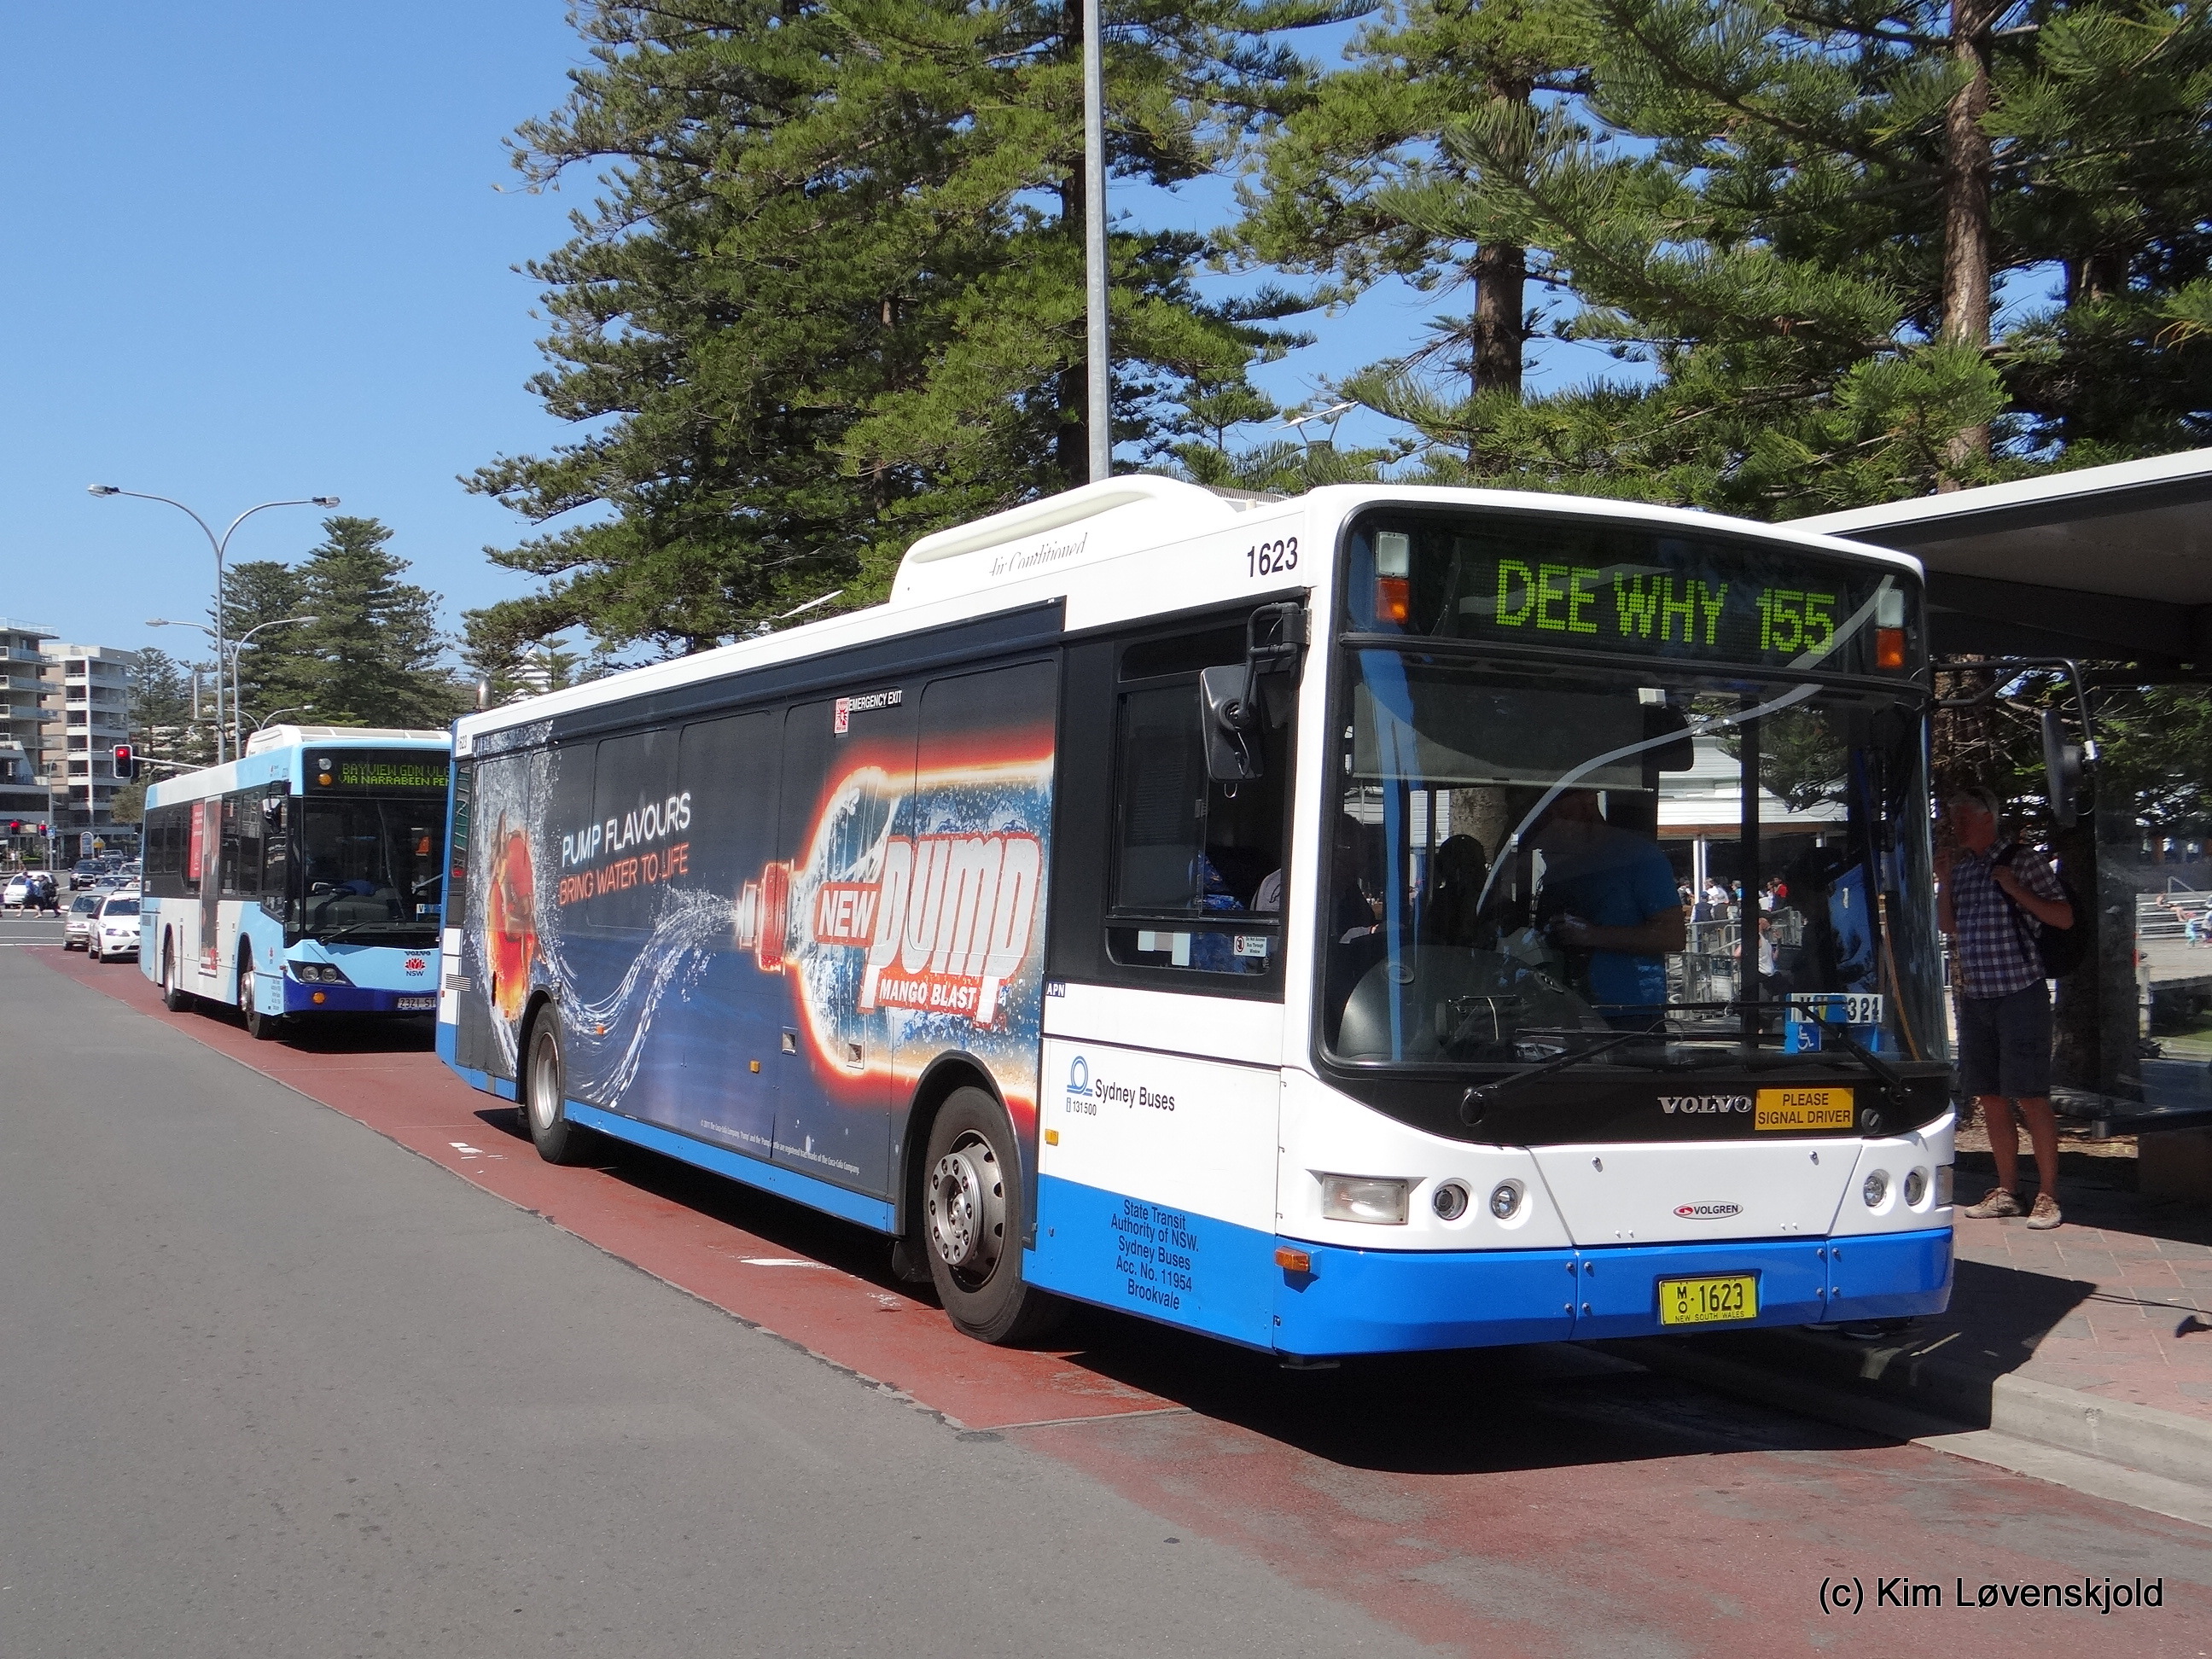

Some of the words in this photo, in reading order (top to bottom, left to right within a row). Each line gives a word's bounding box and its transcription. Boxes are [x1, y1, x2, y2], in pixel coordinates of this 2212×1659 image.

[1246, 536, 1299, 578] 1623
[1496, 558, 1599, 634] DEE
[1614, 571, 1729, 646] WHY
[1755, 587, 1836, 655] 155
[848, 693, 888, 712] EMERGENCY
[888, 690, 902, 705] EXIT
[338, 775, 358, 785] VIA
[360, 775, 430, 786] NARRABEEN
[342, 763, 397, 777] BAYVIEW
[399, 765, 424, 777] GDN
[562, 824, 601, 869] PUMP
[604, 792, 691, 854] FLAVOURS
[559, 871, 594, 906] BRING
[597, 859, 638, 895] WATER
[641, 853, 659, 884] TO
[661, 841, 690, 881] LIFE
[817, 889, 877, 939] NEW
[879, 978, 928, 1003] MANGO
[932, 981, 977, 1010] BLAST
[1046, 982, 1065, 998] APN
[1095, 1078, 1137, 1109] Sydney
[1138, 1086, 1176, 1113] Buses
[1657, 1095, 1752, 1115] VOLVO
[1782, 1092, 1830, 1107] PLEASE
[1757, 1110, 1804, 1126] SIGNAL
[1807, 1109, 1851, 1123] DRIVER
[1124, 1198, 1149, 1221] State
[1151, 1206, 1186, 1231] Transit
[1693, 1204, 1739, 1215] VOLGREN
[1110, 1213, 1155, 1243] Authority
[1158, 1227, 1169, 1243] of
[1172, 1229, 1199, 1253] NSW.
[1118, 1235, 1155, 1264] Sydney
[1158, 1246, 1191, 1272] Buses
[1115, 1254, 1138, 1276] Acc.
[1140, 1261, 1158, 1282] No.
[1161, 1268, 1192, 1292] 11954
[1127, 1278, 1180, 1311] Brookvale
[1699, 1282, 1743, 1313] 1623
[1674, 1314, 1691, 1324] NEW
[1694, 1313, 1719, 1322] SOUTH
[1722, 1310, 1745, 1319] WALES
